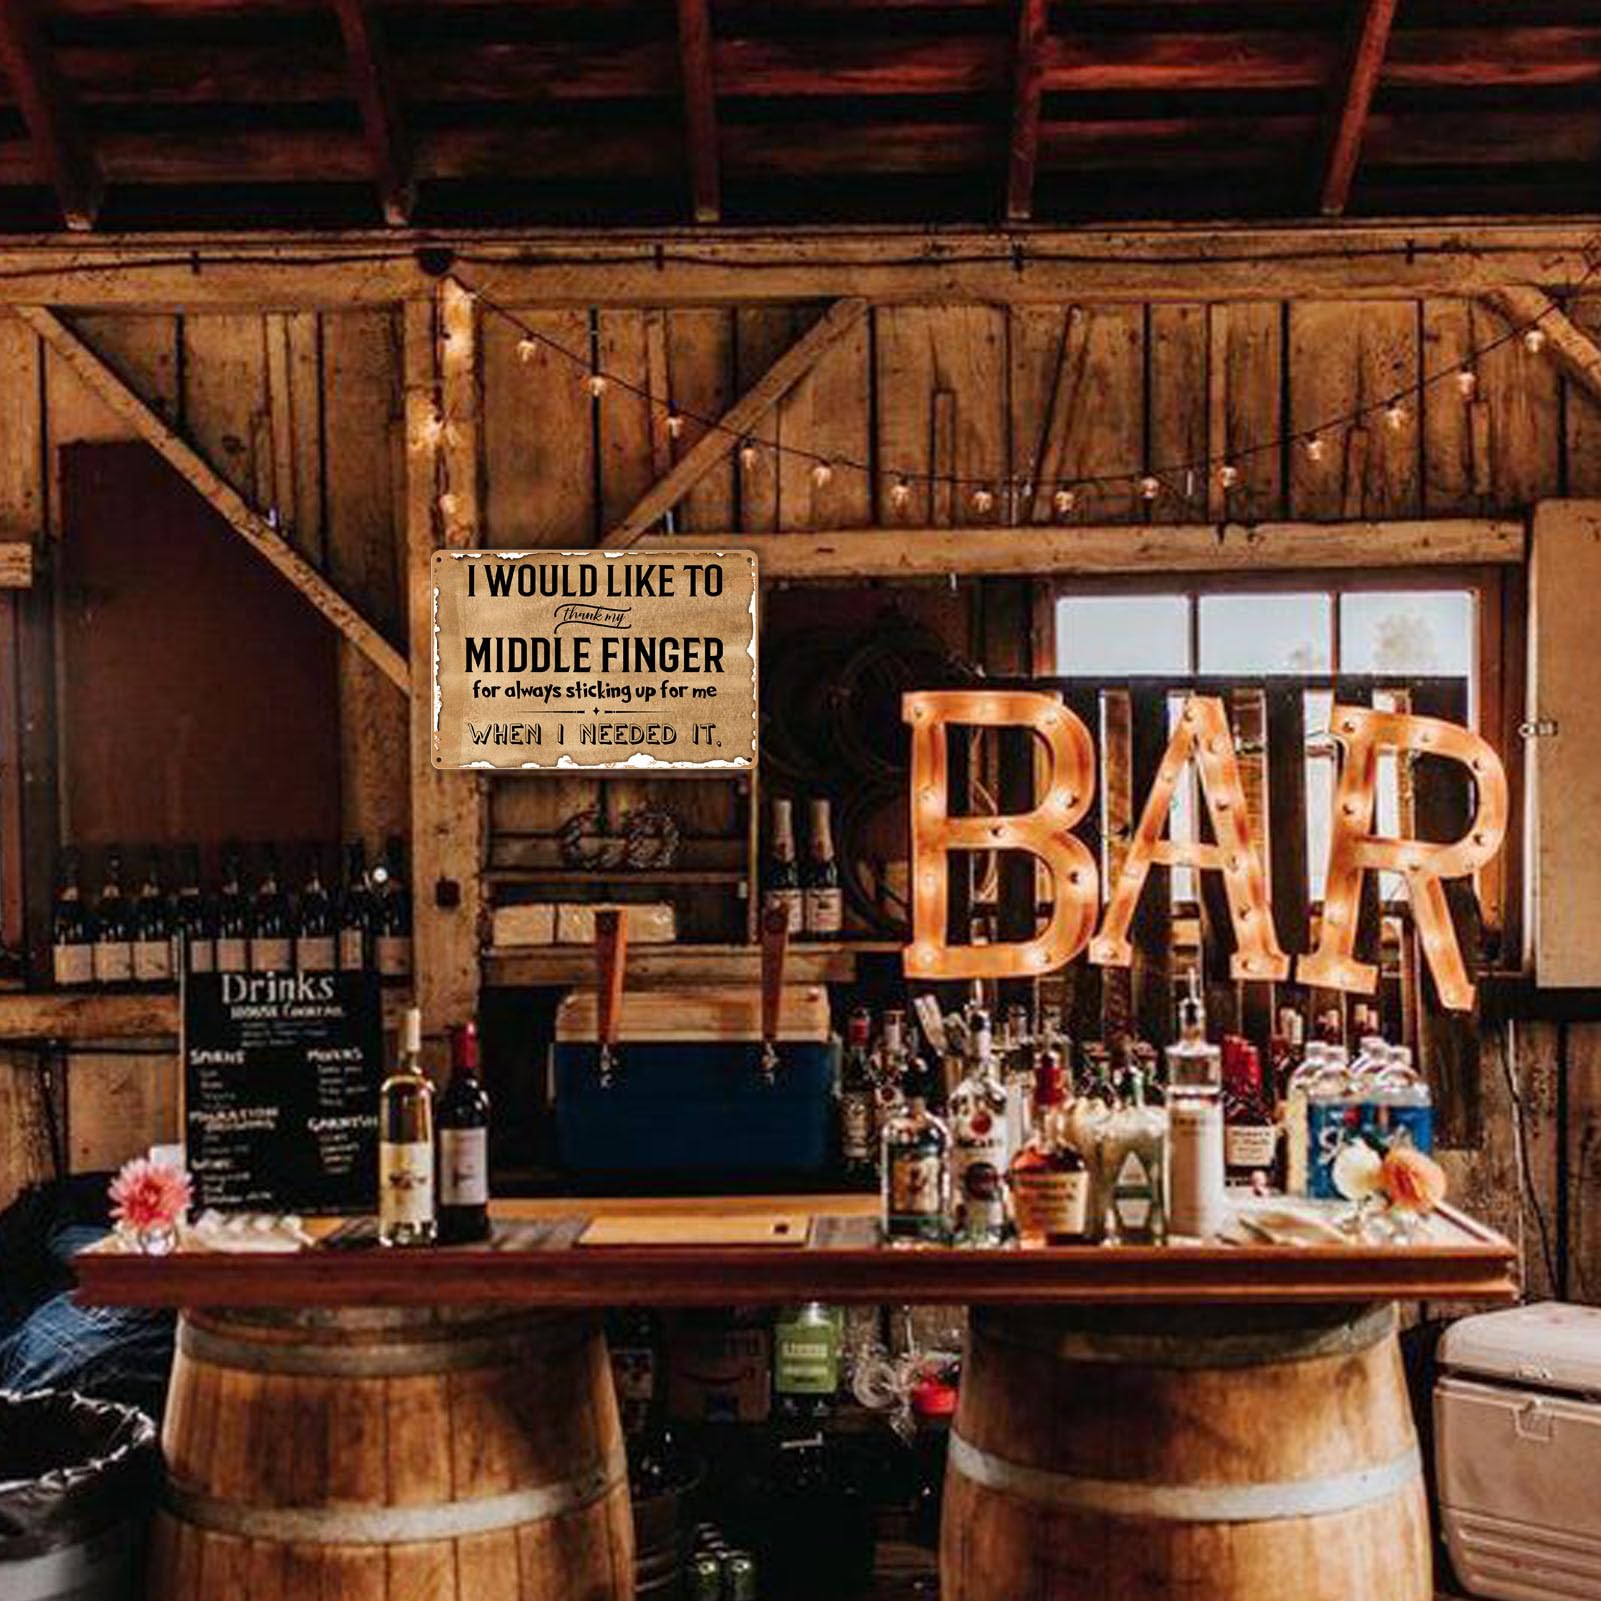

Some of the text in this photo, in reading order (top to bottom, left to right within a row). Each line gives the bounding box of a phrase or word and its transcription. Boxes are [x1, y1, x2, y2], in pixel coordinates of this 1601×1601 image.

[467, 563, 723, 597] I WOULD LIKE TO
[563, 604, 625, 628] thank my
[465, 636, 725, 673] MIDDLE FINGER
[473, 680, 717, 705] for always sticking up for me
[467, 723, 722, 748] WHEN I NEEDED IT.
[903, 691, 1508, 1011] BAR
[222, 970, 335, 1004] Drinks
